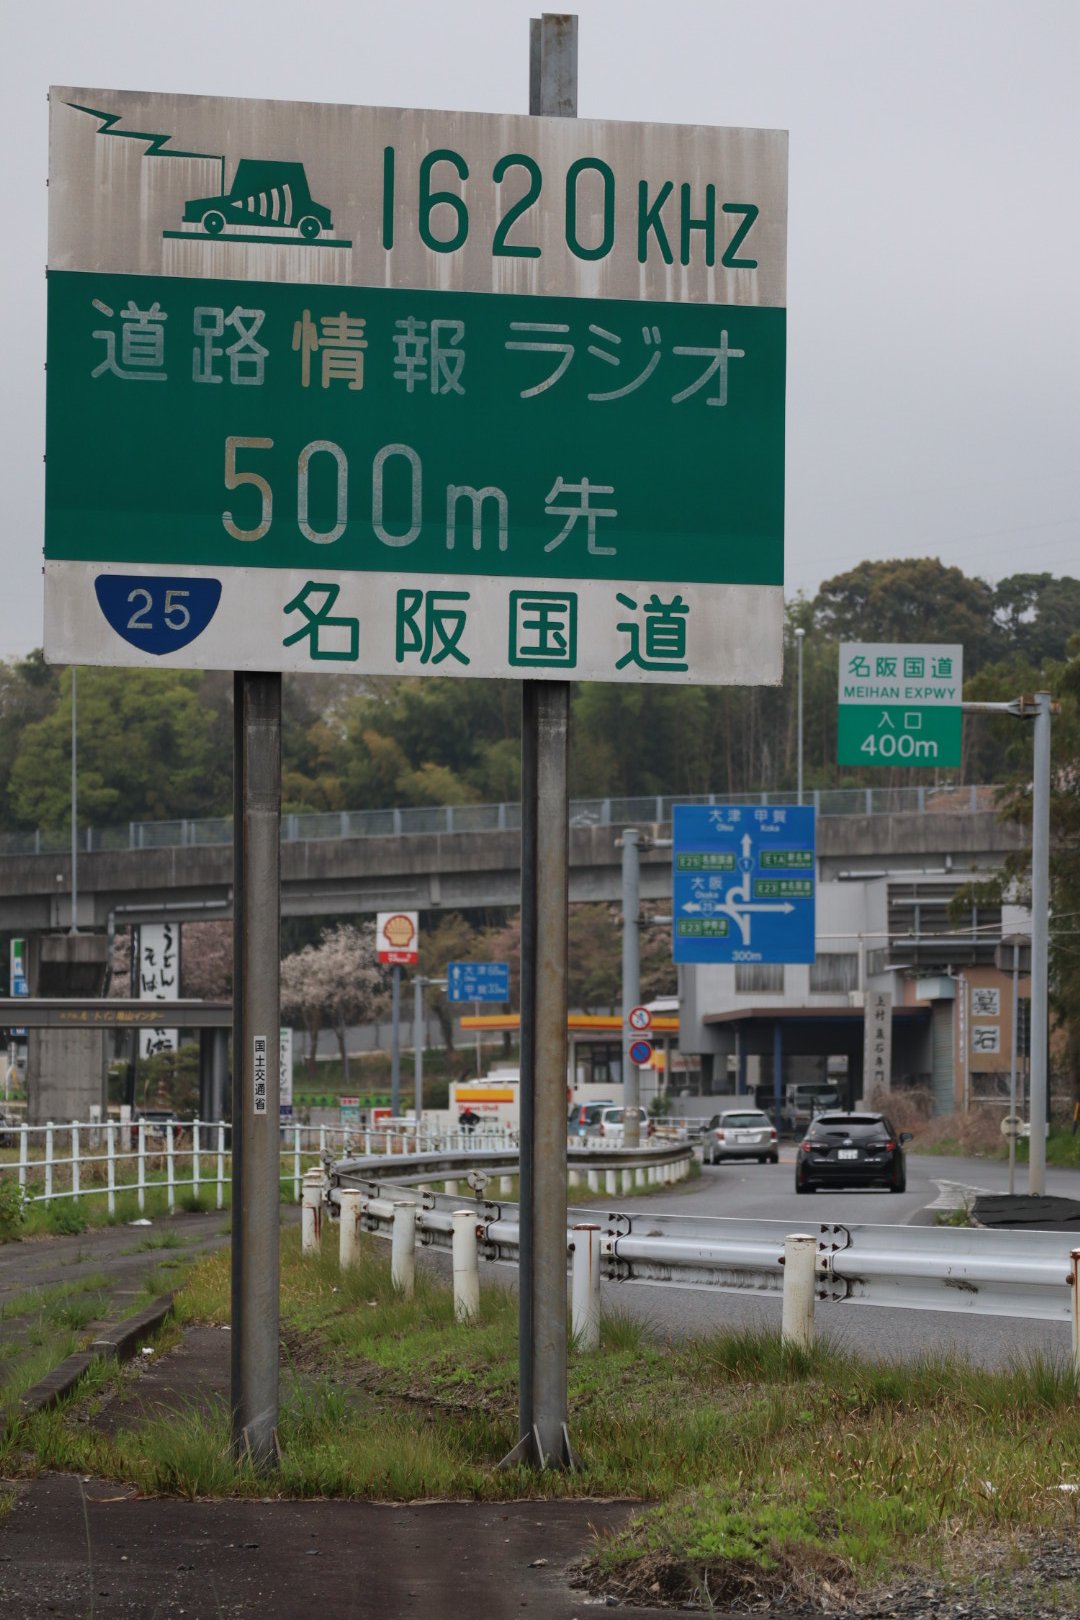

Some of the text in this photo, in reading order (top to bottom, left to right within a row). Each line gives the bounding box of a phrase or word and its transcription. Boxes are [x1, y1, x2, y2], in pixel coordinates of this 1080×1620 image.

[91, 298, 746, 407] 道路情報ラジオ
[126, 590, 191, 631] 25
[282, 580, 690, 673] 名阪国道
[848, 655, 953, 679] 名阪国道
[844, 686, 956, 699] MEIHAN EXPWY
[877, 711, 922, 729] 入口
[860, 734, 938, 758] 400m
[732, 951, 762, 961] 300m
[254, 1039, 266, 1111] 国土交通省
